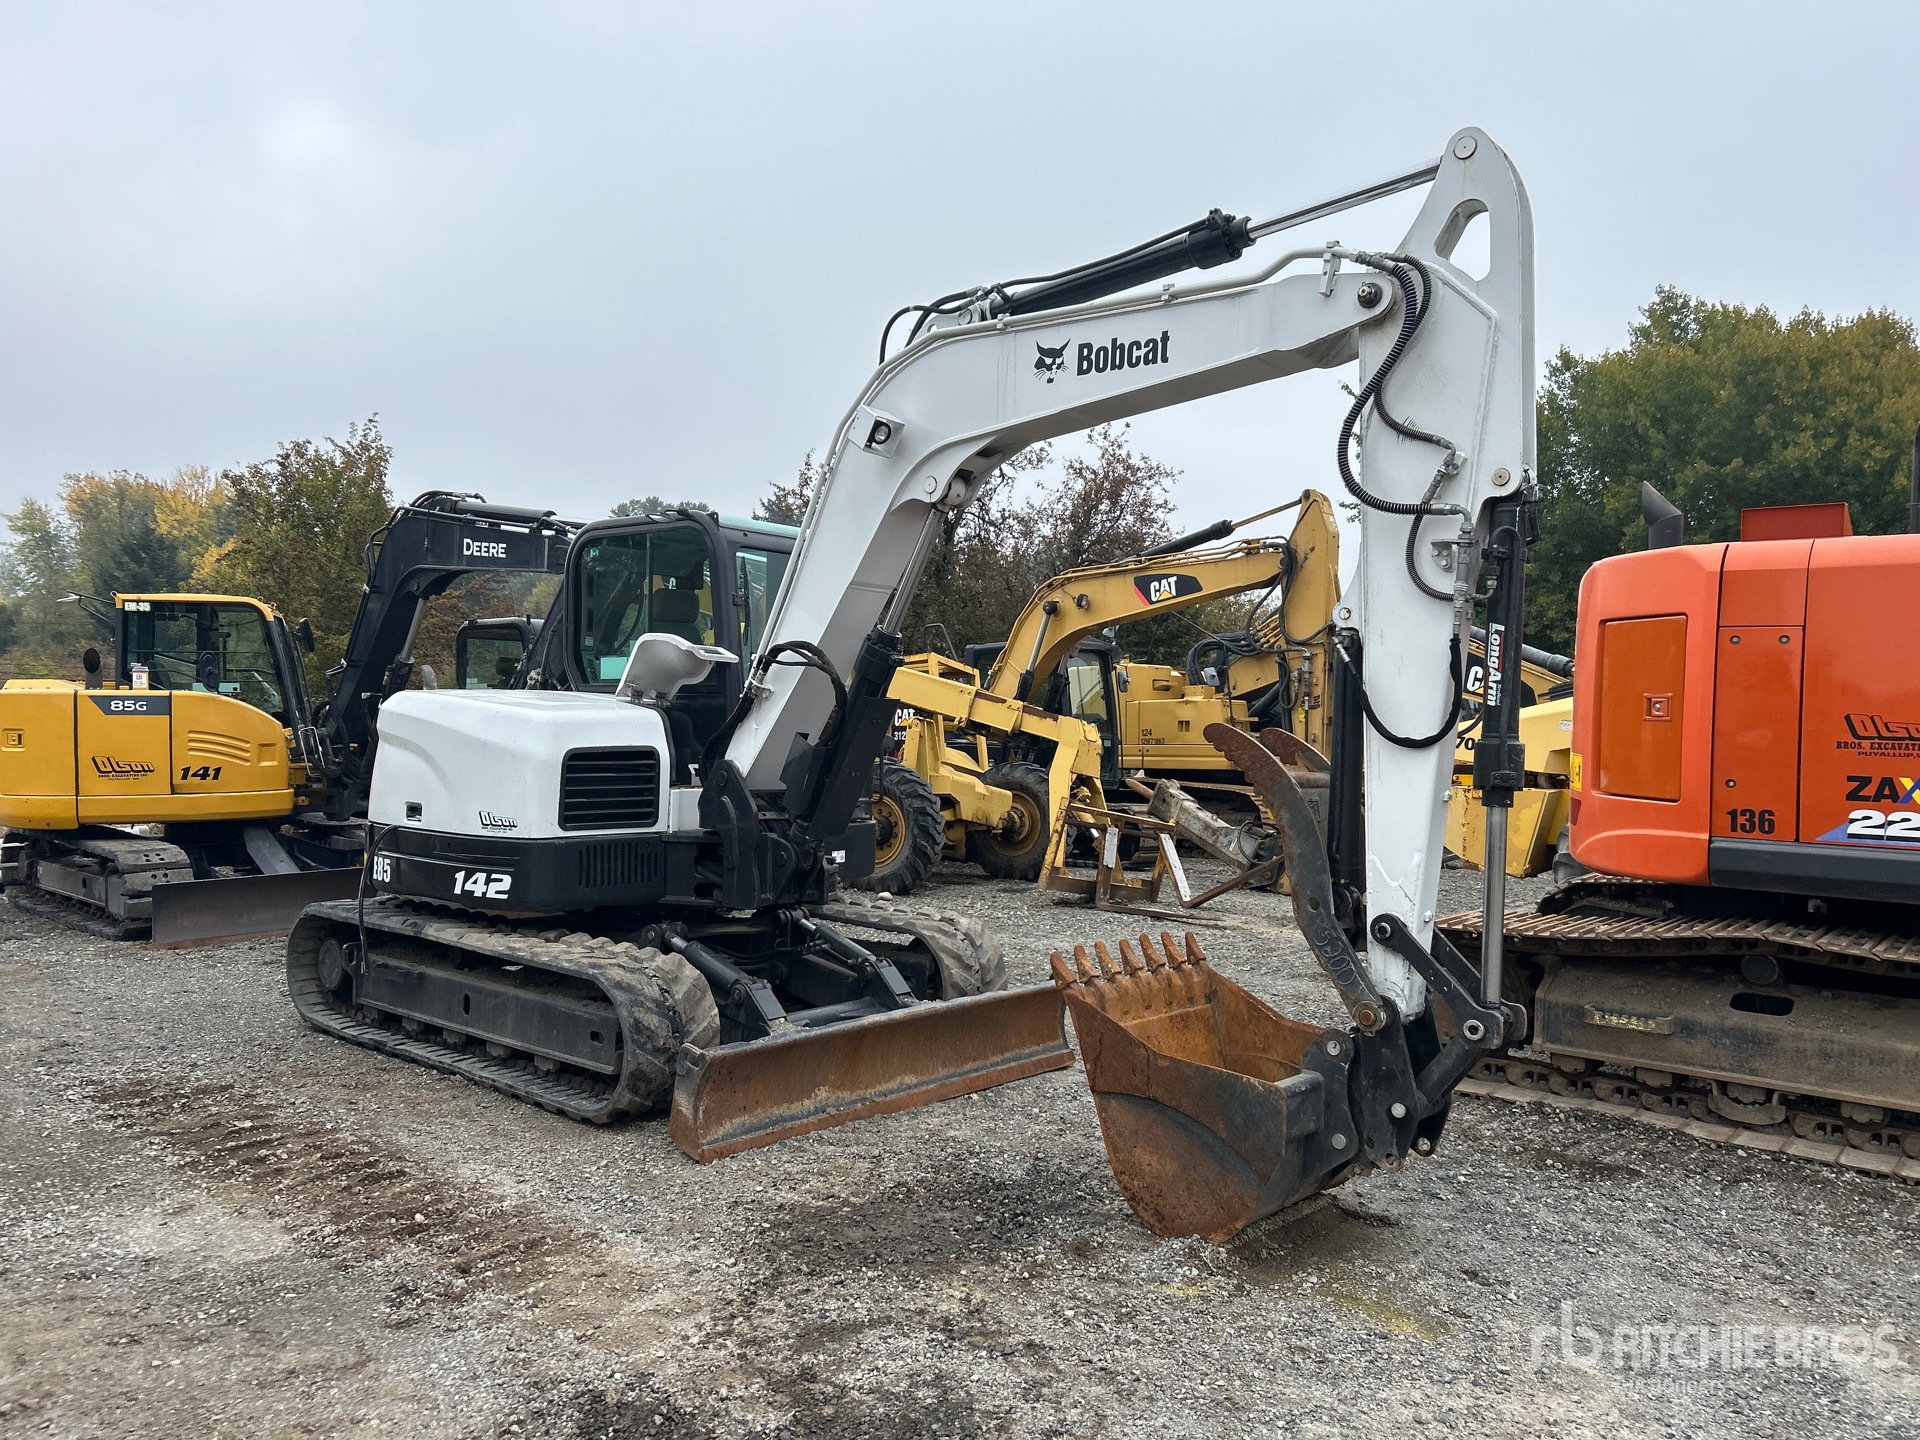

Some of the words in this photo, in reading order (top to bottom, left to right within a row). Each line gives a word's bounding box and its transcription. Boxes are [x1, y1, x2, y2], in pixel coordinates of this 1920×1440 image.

[1077, 330, 1170, 376] Bobcat
[463, 538, 507, 558] DEERE
[1150, 576, 1177, 602] CAT
[124, 601, 151, 611] EM-35
[1487, 622, 1505, 707] LongArm
[110, 700, 147, 711] 85G
[894, 708, 915, 726] CAT
[893, 731, 906, 740] 312
[1141, 728, 1152, 736] 124
[1836, 741, 1865, 750] BROS.
[91, 755, 155, 774] Olson
[180, 766, 222, 780] 141
[478, 810, 518, 828] Olson
[1726, 808, 1776, 834] 136
[373, 856, 391, 883] E85
[453, 870, 512, 899] 142
